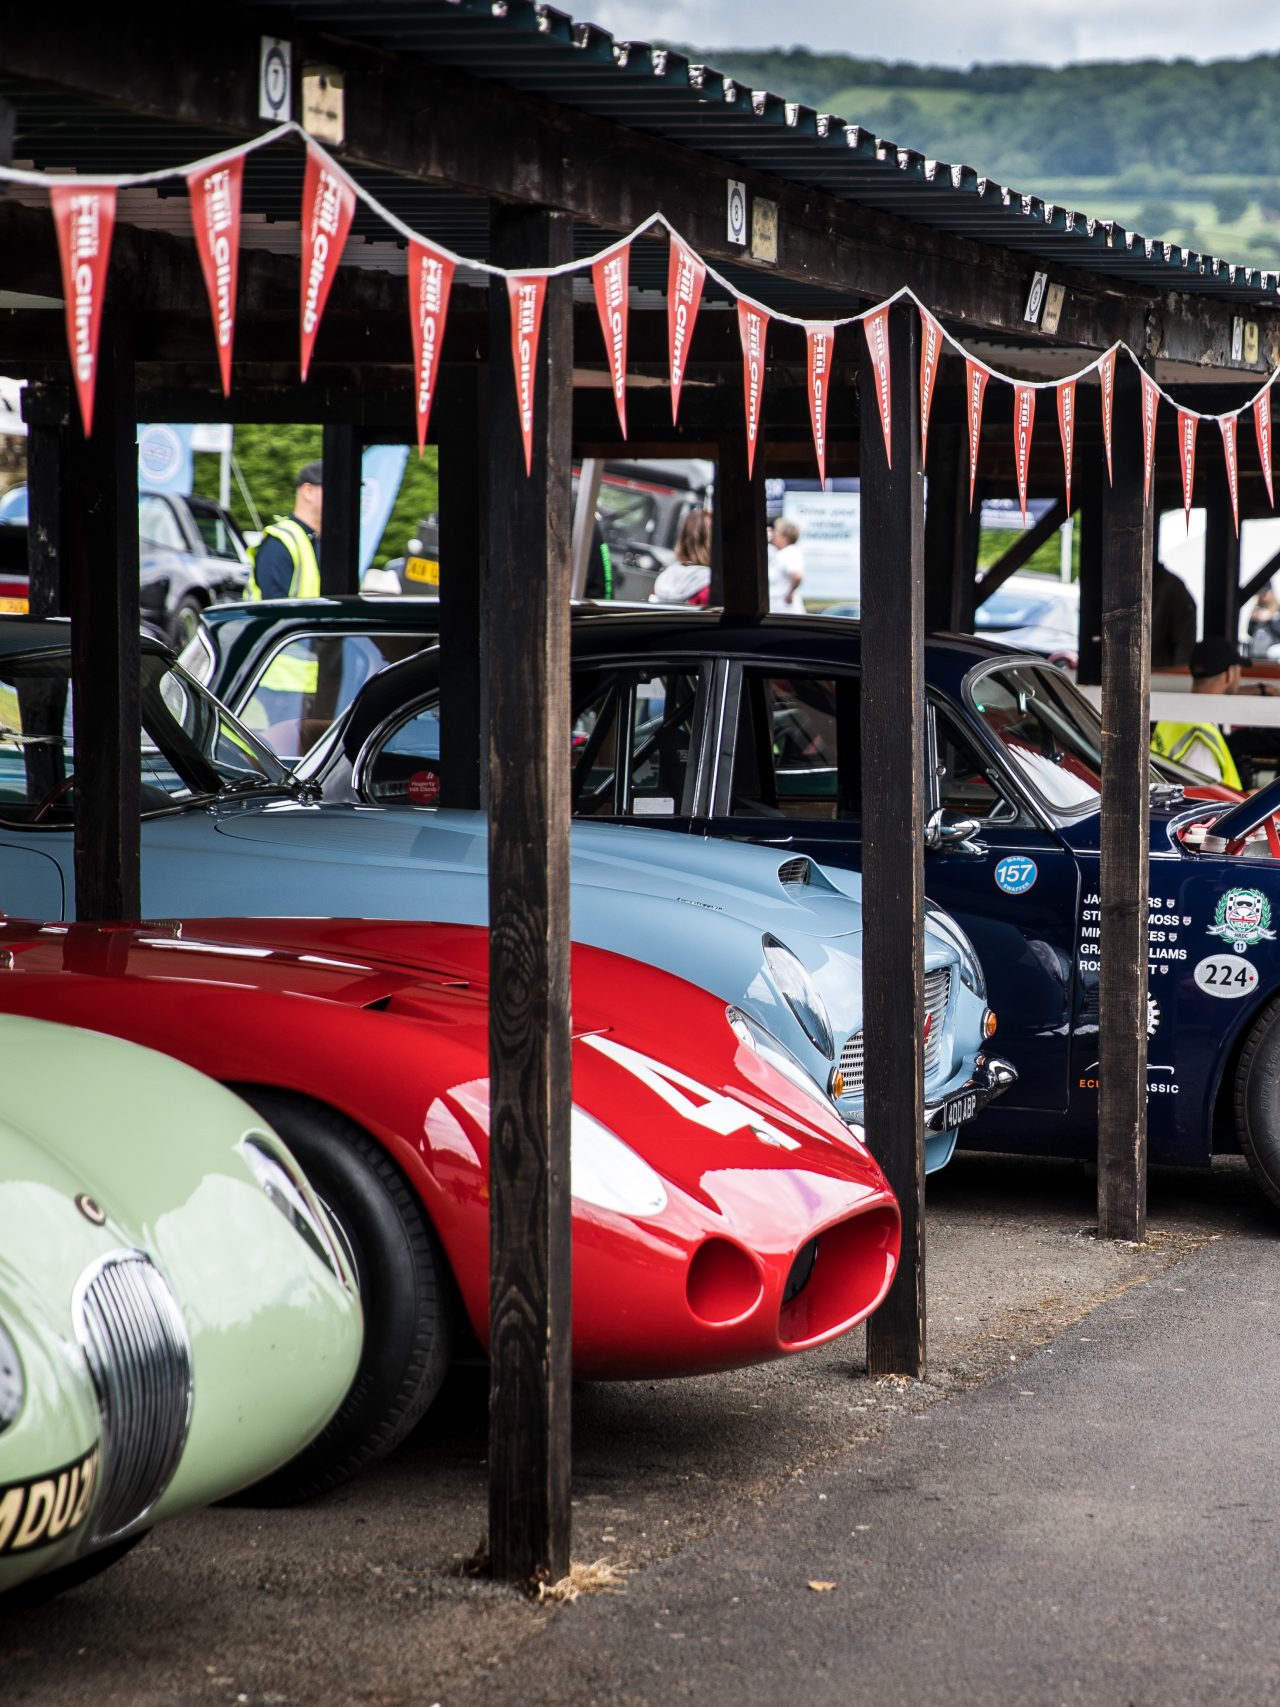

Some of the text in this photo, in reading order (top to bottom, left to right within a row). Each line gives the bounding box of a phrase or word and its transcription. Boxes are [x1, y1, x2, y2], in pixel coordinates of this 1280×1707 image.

[272, 68, 280, 91] 7
[319, 174, 338, 231] Hill
[211, 171, 232, 346] Hill Climb
[303, 233, 328, 334] Climb
[425, 258, 438, 312] Hill
[608, 257, 620, 307] Hill
[679, 252, 692, 302] Hill
[76, 195, 93, 382] Hill Climb
[418, 316, 436, 414] Climb
[521, 284, 532, 432] Hill Climb
[612, 311, 624, 399] Climb
[672, 304, 686, 385] Climb
[927, 324, 936, 365] Hill
[749, 313, 758, 441] Hill Climb
[874, 316, 890, 435] Hill Climb
[922, 366, 930, 435] Climb
[815, 378, 824, 456] Climb
[998, 864, 1033, 883] 157
[1002, 882, 1030, 892] SWAFFER
[1083, 894, 1101, 905] JA
[1236, 943, 1245, 951] 11
[1204, 964, 1248, 988] 224
[948, 1094, 976, 1127] 400 ABP
